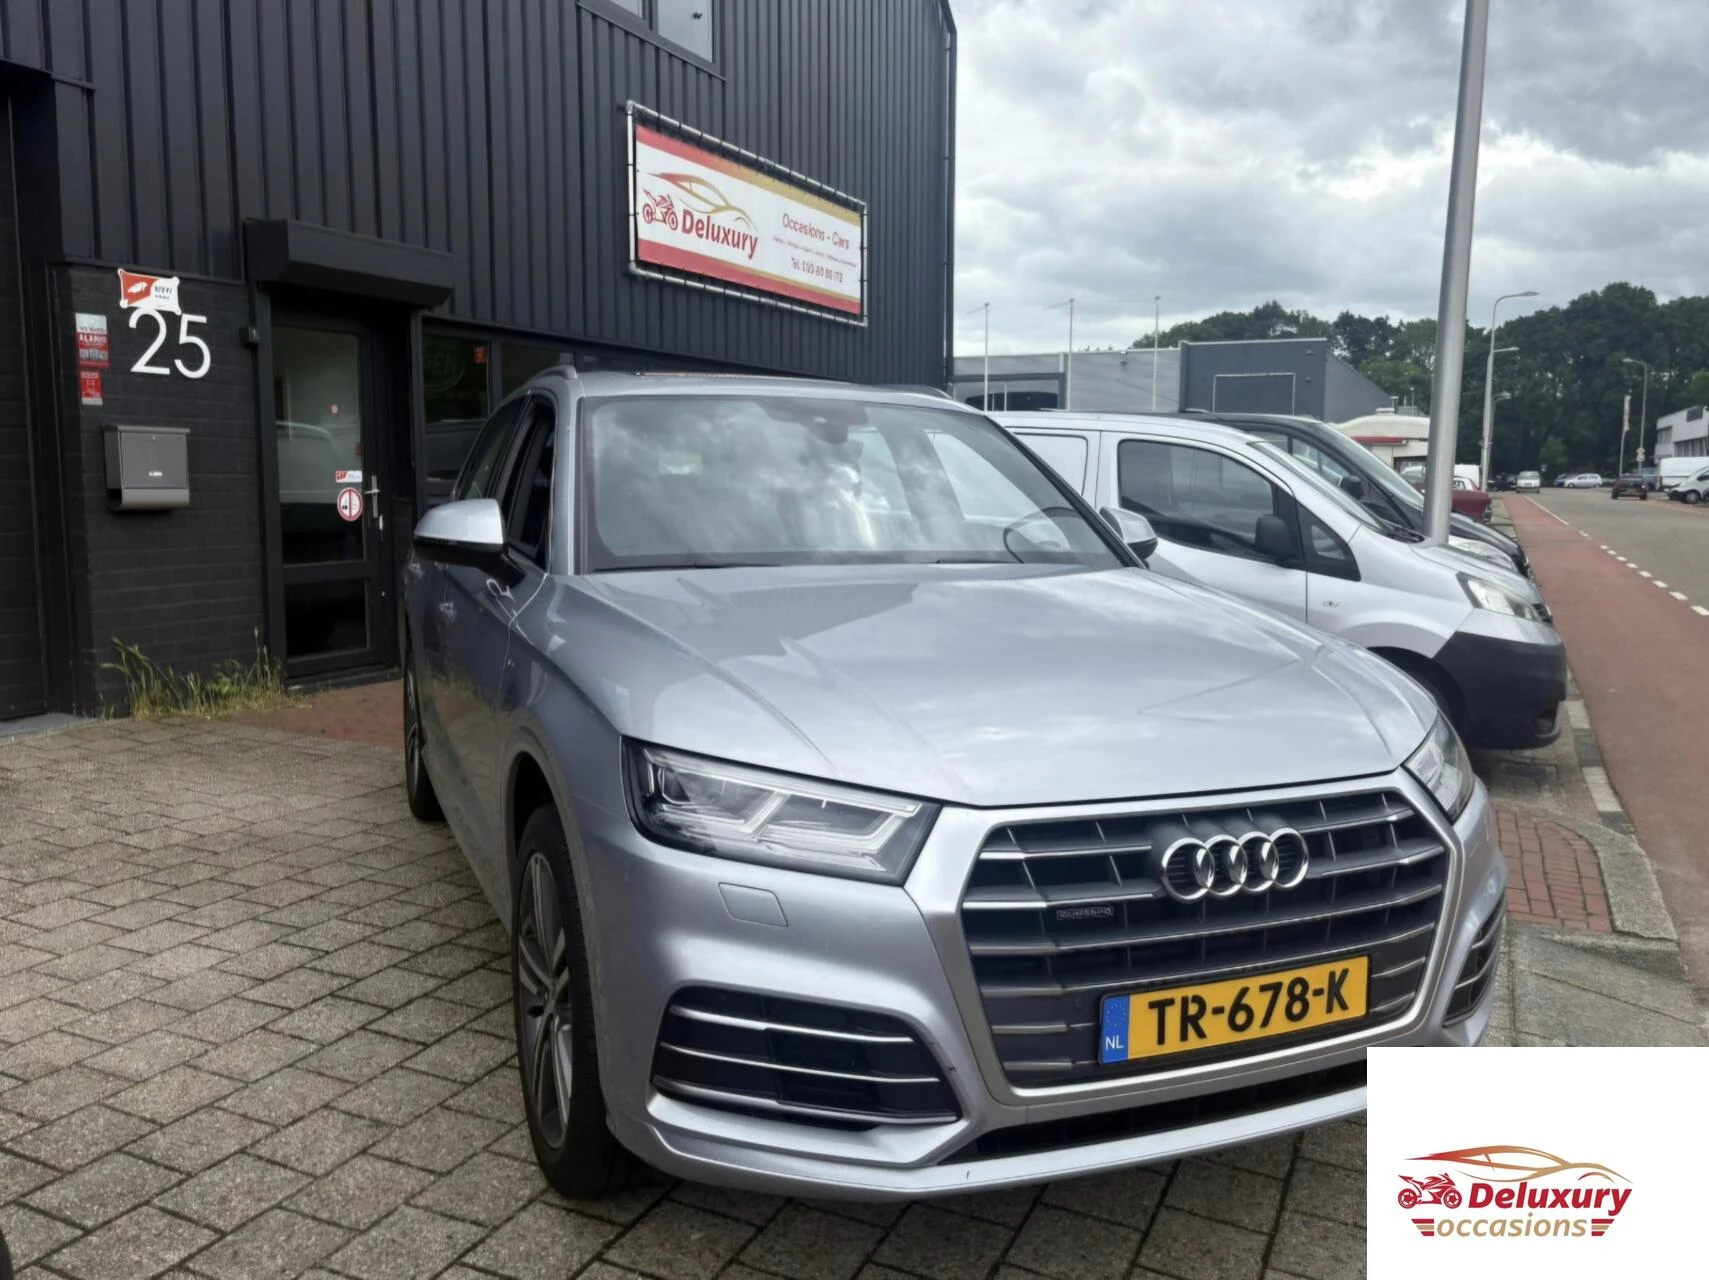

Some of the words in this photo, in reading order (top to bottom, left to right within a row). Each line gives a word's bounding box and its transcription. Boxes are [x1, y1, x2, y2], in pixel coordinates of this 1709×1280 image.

[682, 209, 758, 259] Deluxury
[782, 213, 824, 241] Occasions
[831, 231, 850, 250] Cars
[129, 307, 211, 379] 25
[1148, 968, 1350, 1046] TR-678-K
[1105, 1036, 1124, 1050] NL
